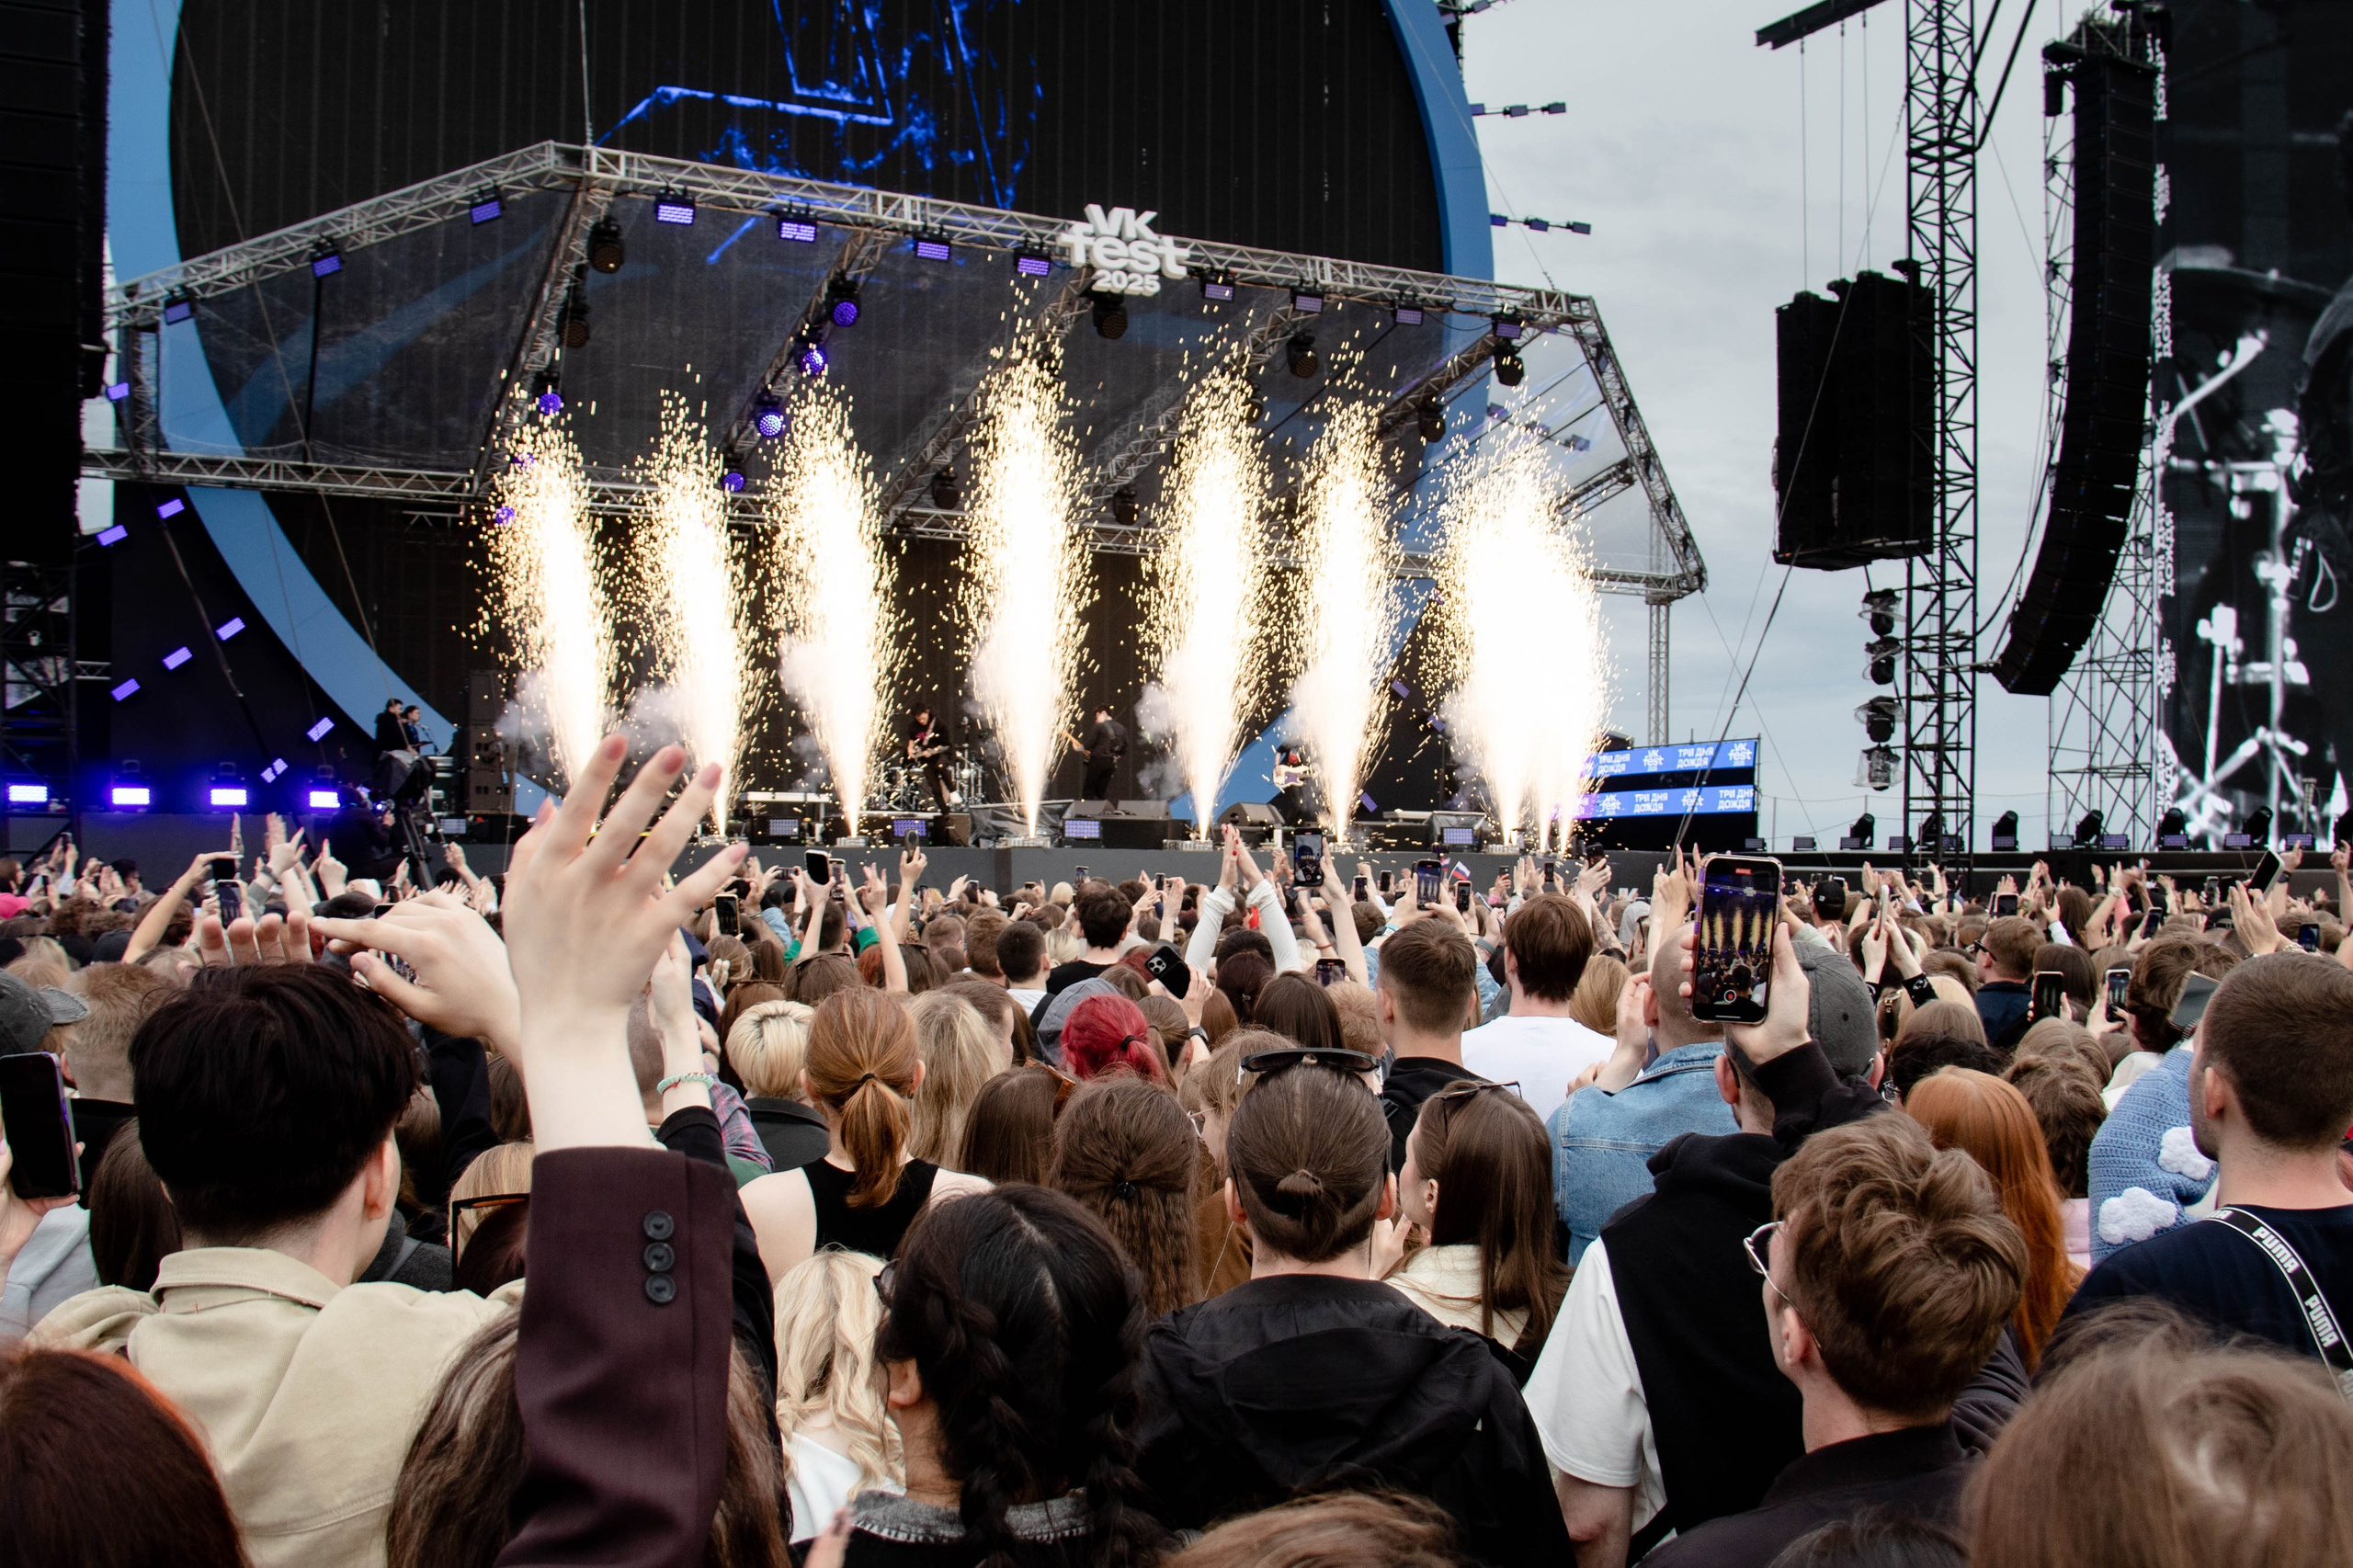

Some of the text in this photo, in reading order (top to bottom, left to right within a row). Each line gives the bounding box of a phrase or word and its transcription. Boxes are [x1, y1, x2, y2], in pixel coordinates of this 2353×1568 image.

[1084, 203, 1158, 243] VK
[1059, 222, 1190, 279] fest
[1091, 269, 1161, 296] 2025
[1678, 746, 1714, 758] ТРИ ДНЯ
[1733, 743, 1747, 751] VK
[1728, 749, 1752, 761] fest
[1677, 757, 1709, 769] ДОЖДЯ
[1634, 792, 1668, 802] ТРИ ДНЯ
[1719, 790, 1735, 799] ТРИ
[1718, 799, 1751, 811] ДОЖДЯ
[2252, 1225, 2300, 1274] PUMA
[2304, 1294, 2340, 1347] PUMA
